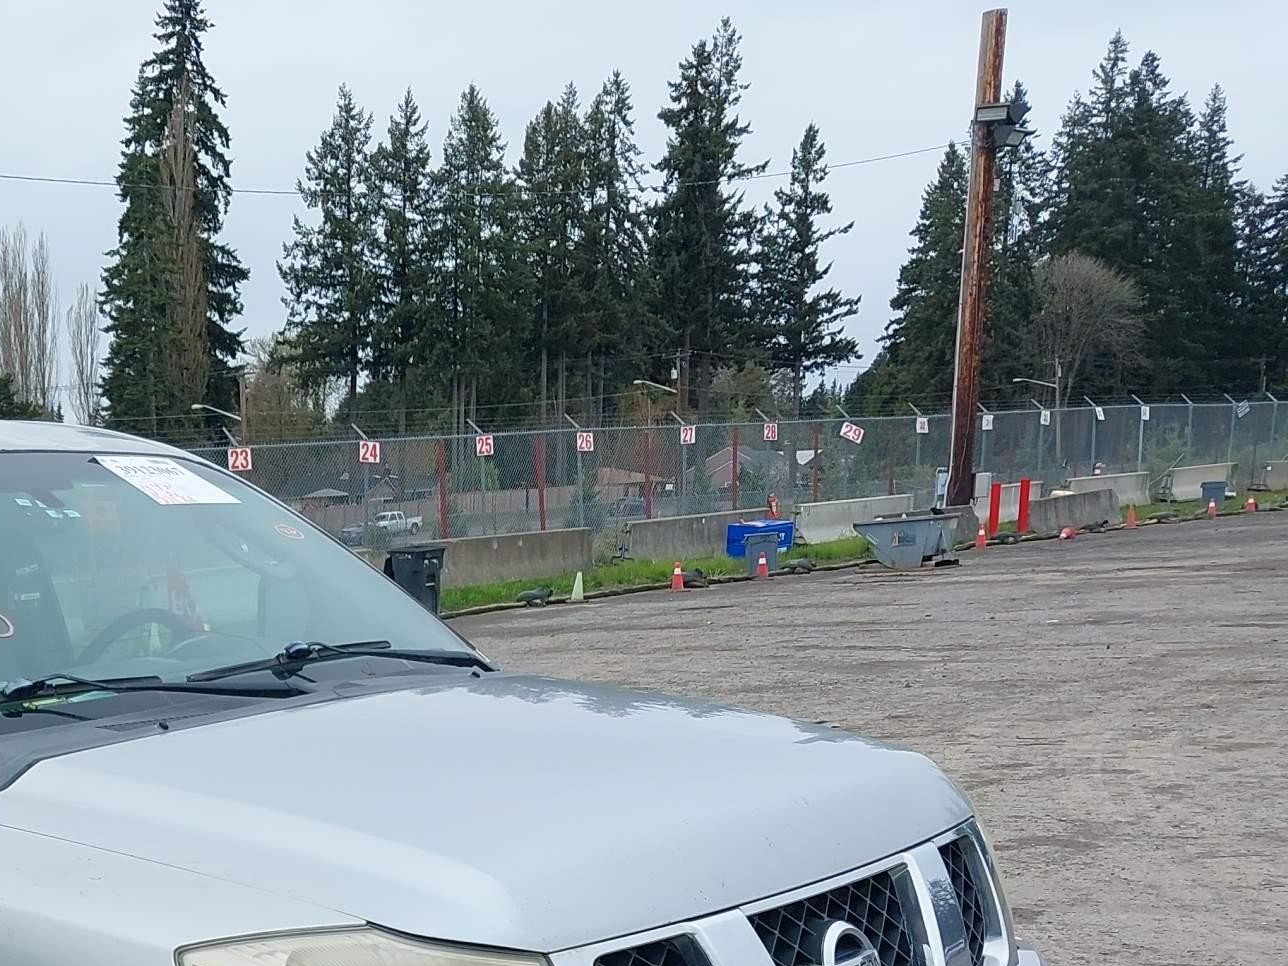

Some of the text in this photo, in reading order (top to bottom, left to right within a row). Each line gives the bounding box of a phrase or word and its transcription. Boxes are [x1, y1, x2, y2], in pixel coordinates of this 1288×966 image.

[682, 427, 694, 443] 27
[765, 424, 776, 440] 28
[843, 424, 862, 441] 29
[477, 437, 492, 455] 25
[578, 433, 592, 450] 26
[230, 450, 250, 470] 23
[361, 442, 378, 462] 24
